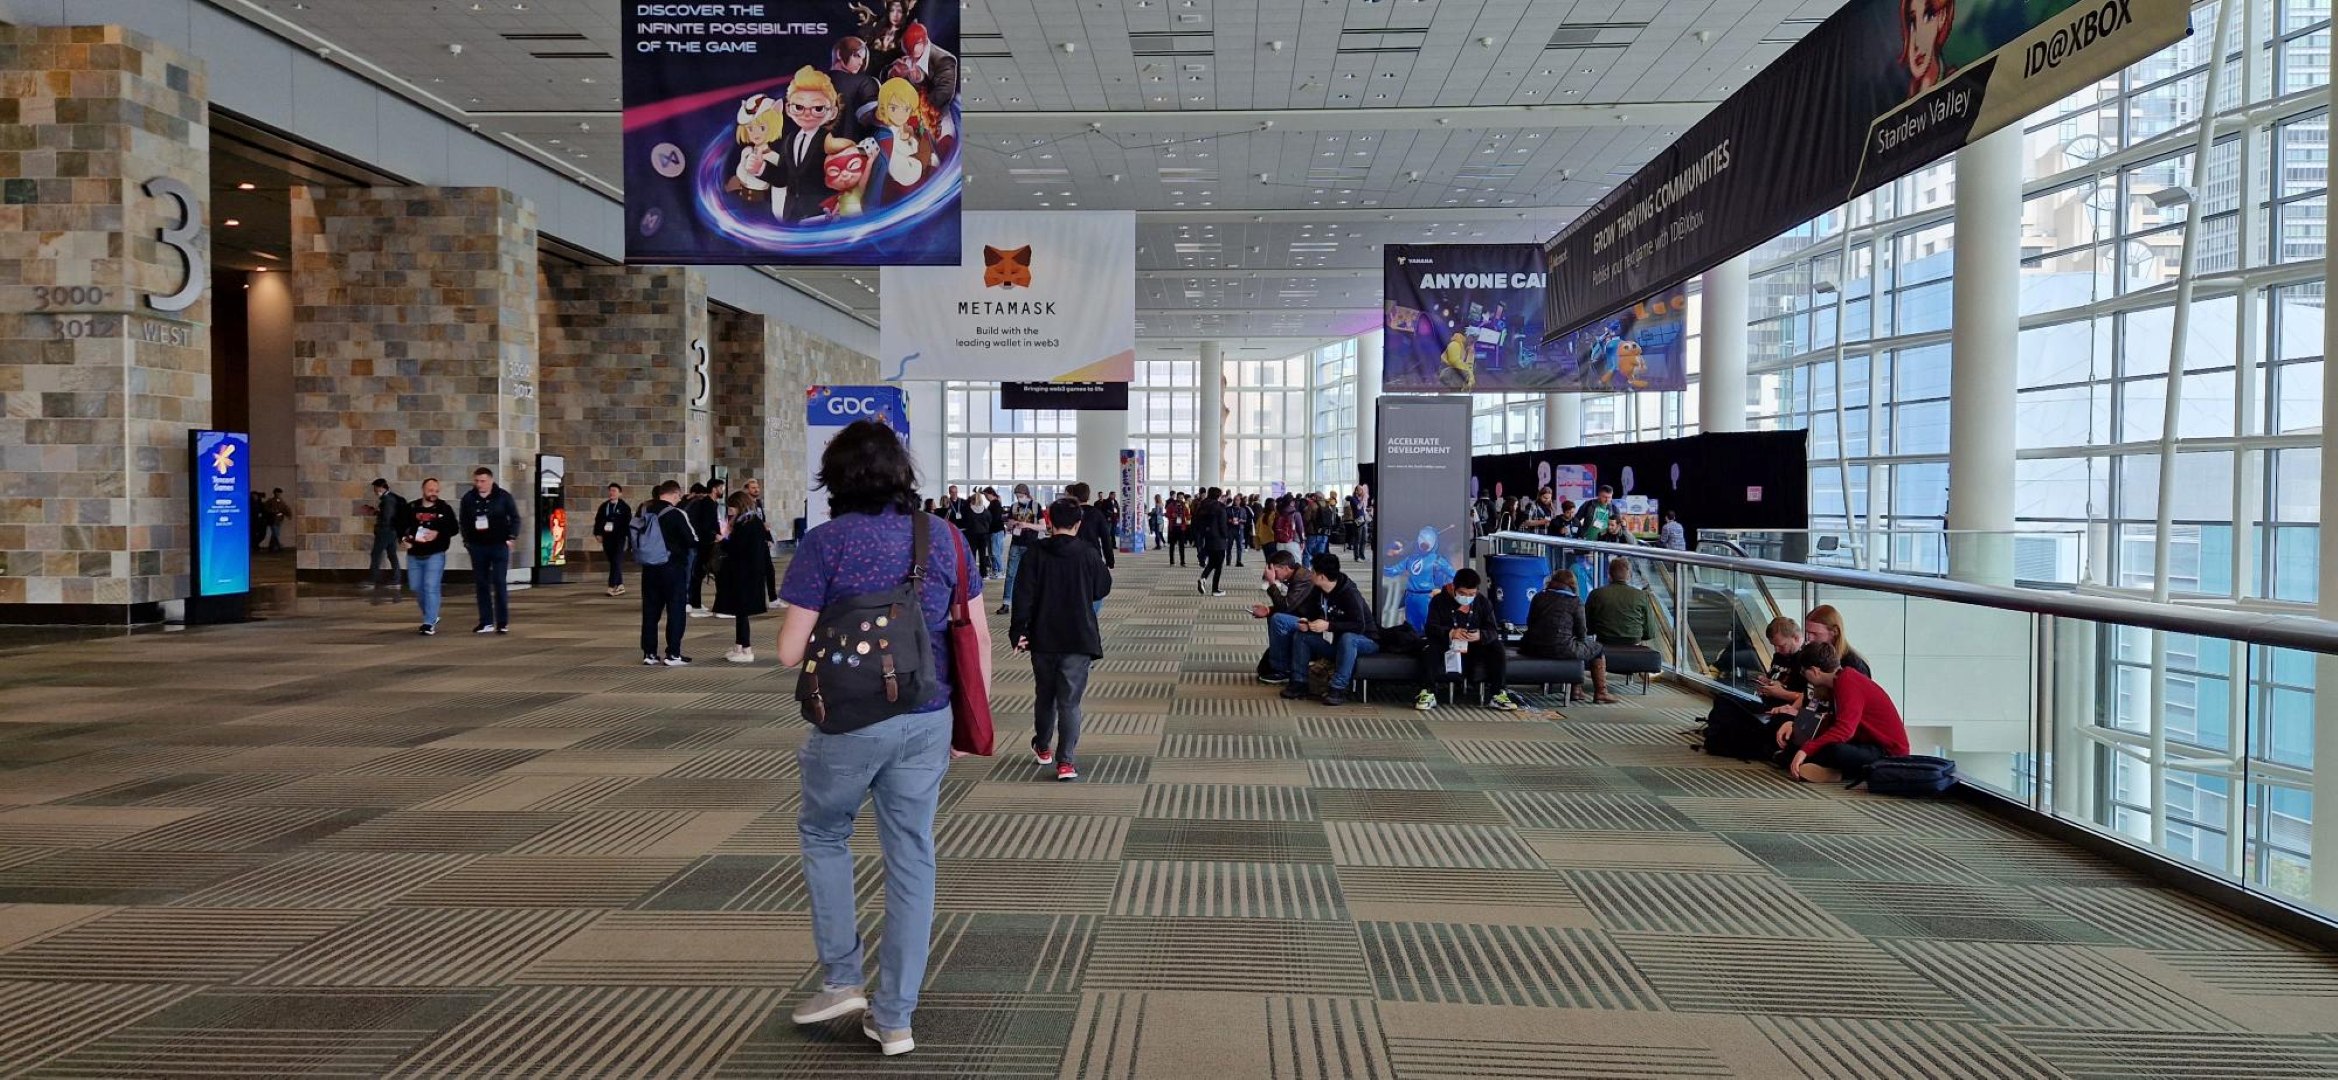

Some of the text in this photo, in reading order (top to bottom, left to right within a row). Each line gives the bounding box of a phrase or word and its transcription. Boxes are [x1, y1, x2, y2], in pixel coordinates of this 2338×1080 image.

[637, 4, 765, 16] DISCOVER THE
[637, 23, 829, 35] INFINITE POSSIBILITIES
[637, 41, 758, 53] OF THE GAME
[2023, 0, 2133, 79] ID@XBOX
[1877, 88, 1971, 154] Stardew Valley
[1592, 138, 1730, 255] GROW THRIVING COMMUNITIES
[141, 175, 204, 312] 3
[1419, 272, 1508, 289] ANYONE
[957, 301, 1056, 315] METAMASK
[54, 319, 114, 344] 3012
[142, 322, 191, 348] WEST
[976, 326, 1039, 335] Build with the
[955, 339, 1060, 349] leading wallet in web3
[691, 338, 710, 406] 3
[827, 397, 875, 415] GDC
[1387, 437, 1440, 446] ACCELERATE
[1387, 446, 1451, 454] DEVELOPMENT
